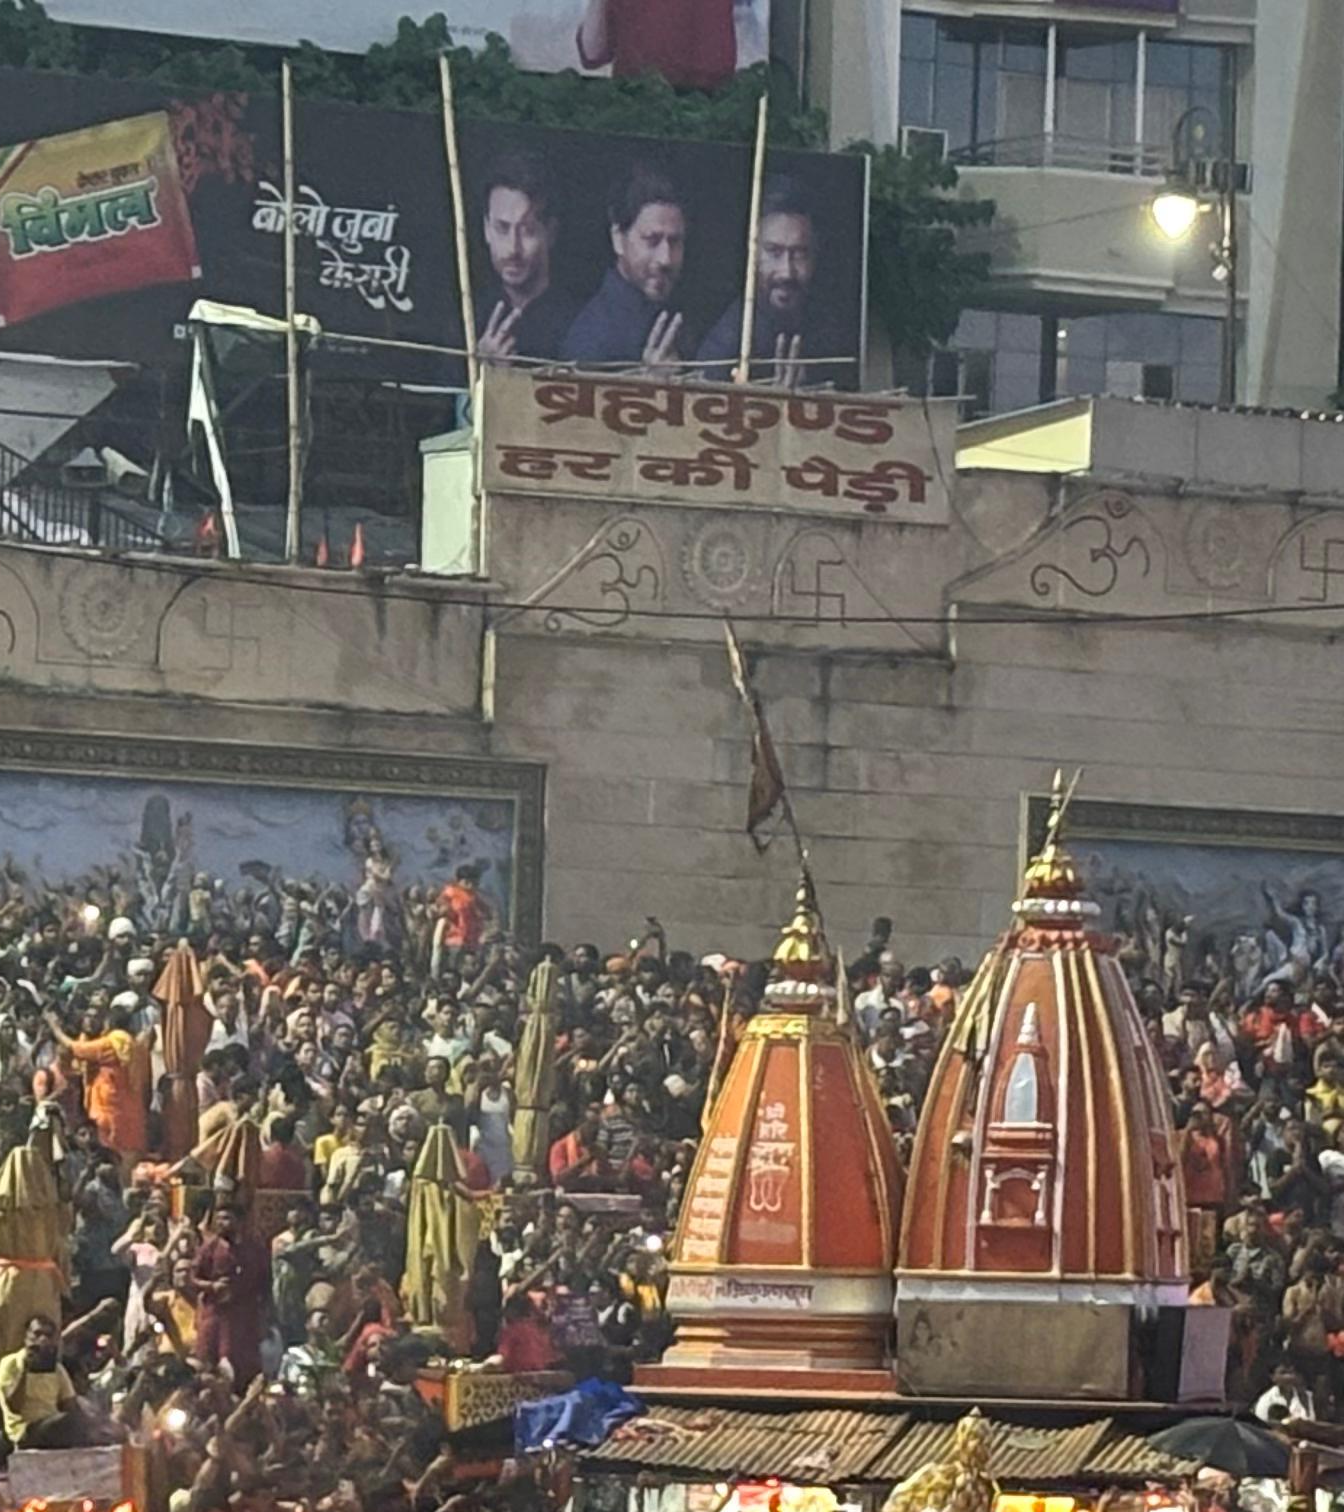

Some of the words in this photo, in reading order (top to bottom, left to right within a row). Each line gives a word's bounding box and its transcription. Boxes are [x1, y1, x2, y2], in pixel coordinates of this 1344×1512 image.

[252, 180, 331, 238] बोलो
[533, 374, 903, 448] ब्रह्मकुण्ड
[495, 444, 621, 480] हर
[636, 447, 758, 490] की
[780, 455, 933, 512] पैड़ी
